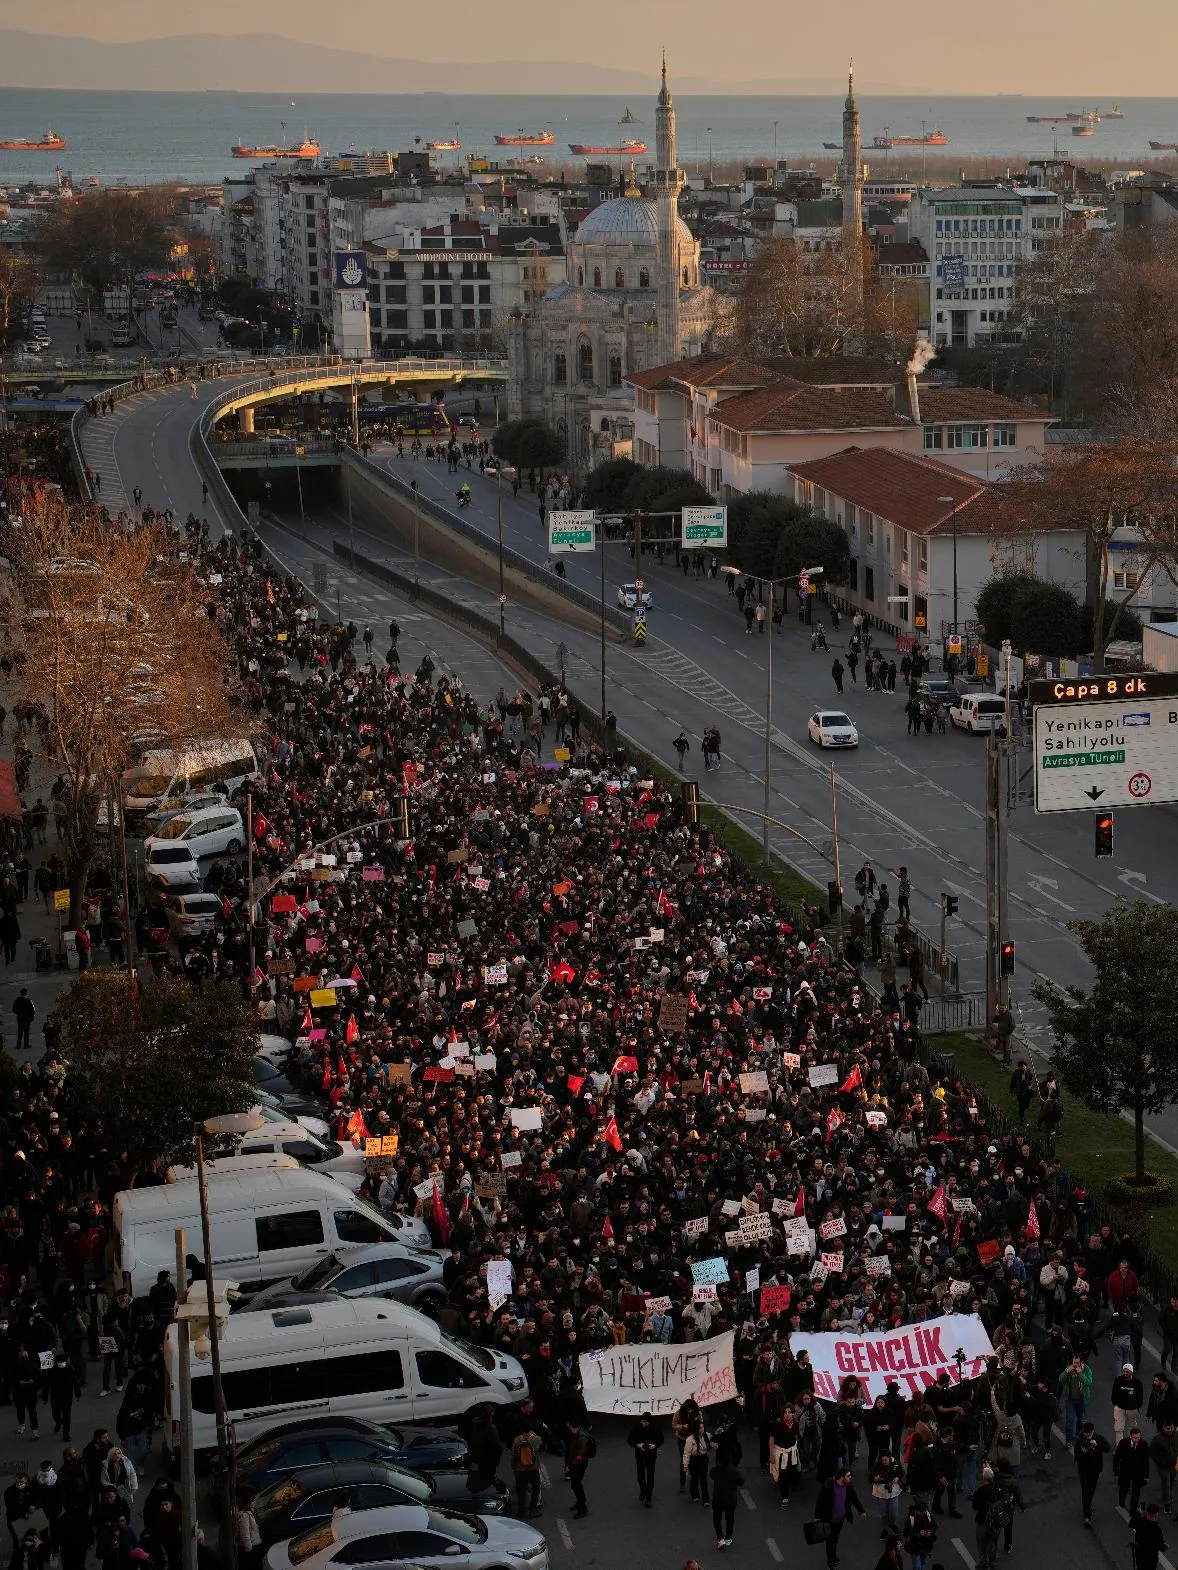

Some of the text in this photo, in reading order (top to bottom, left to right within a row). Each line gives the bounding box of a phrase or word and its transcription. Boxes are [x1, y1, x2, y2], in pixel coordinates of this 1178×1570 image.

[416, 253, 492, 261] MIDPOINT HOTEL
[1054, 679, 1147, 699] Çapa 8 dk
[1045, 718, 1119, 733] Yenikapı
[1045, 734, 1125, 751] Sahilyolu
[1044, 755, 1086, 767] Avrasya
[834, 1326, 948, 1373] GENÇLİK
[598, 1350, 716, 1390] HÜKÜMET
[813, 1371, 874, 1406] BİT
